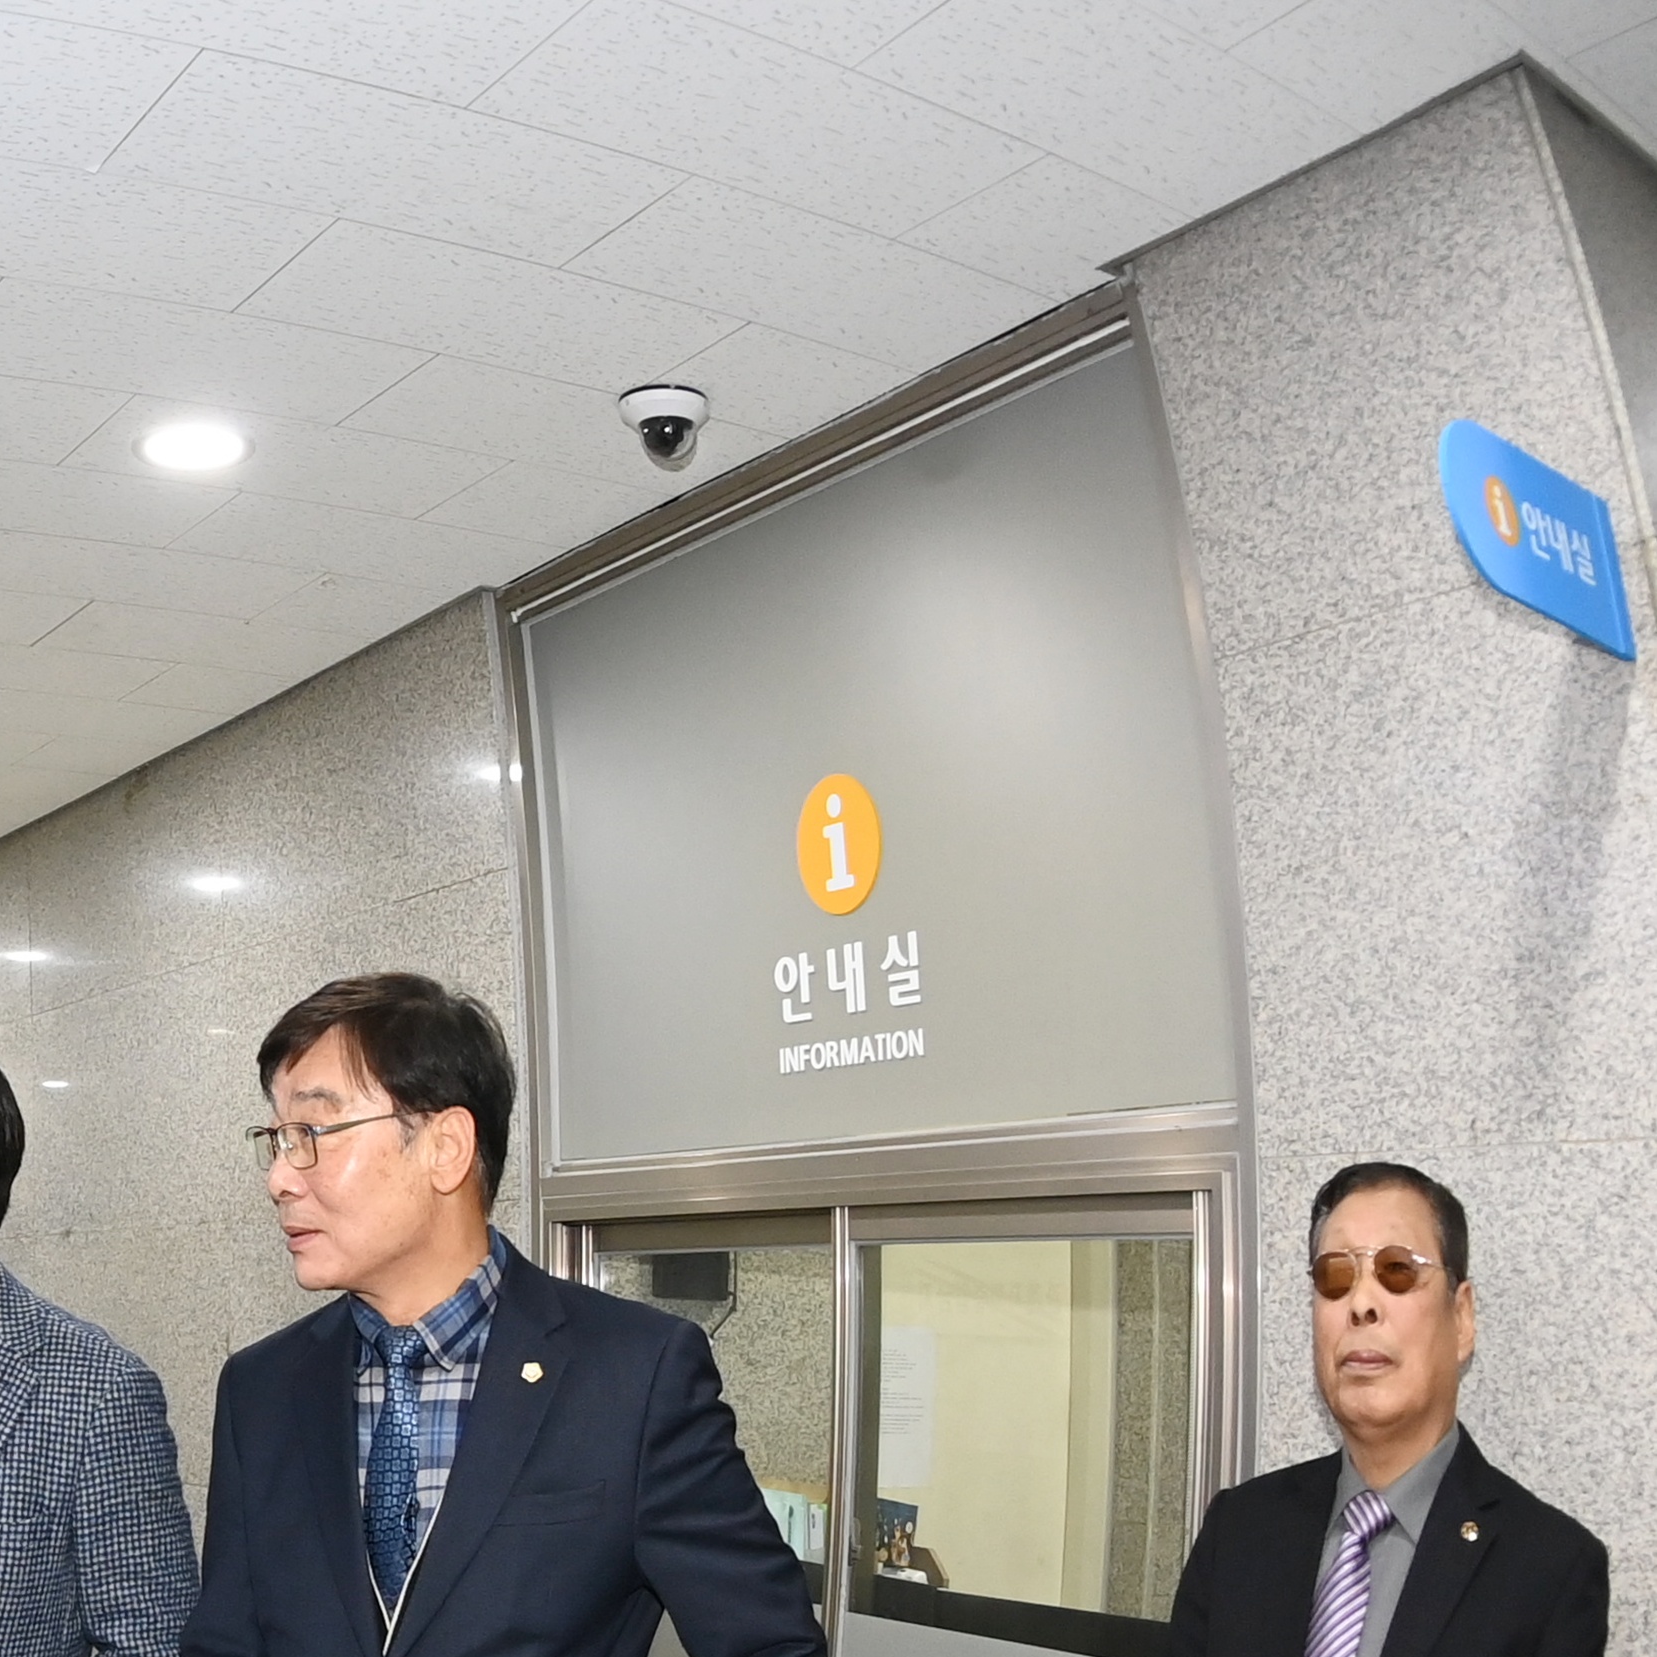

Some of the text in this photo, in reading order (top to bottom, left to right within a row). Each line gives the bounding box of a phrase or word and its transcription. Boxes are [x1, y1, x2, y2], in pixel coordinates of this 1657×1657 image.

[1521, 501, 1597, 586] 안내실
[774, 930, 922, 1024] 안내실
[779, 1027, 926, 1075] INFORMATION
